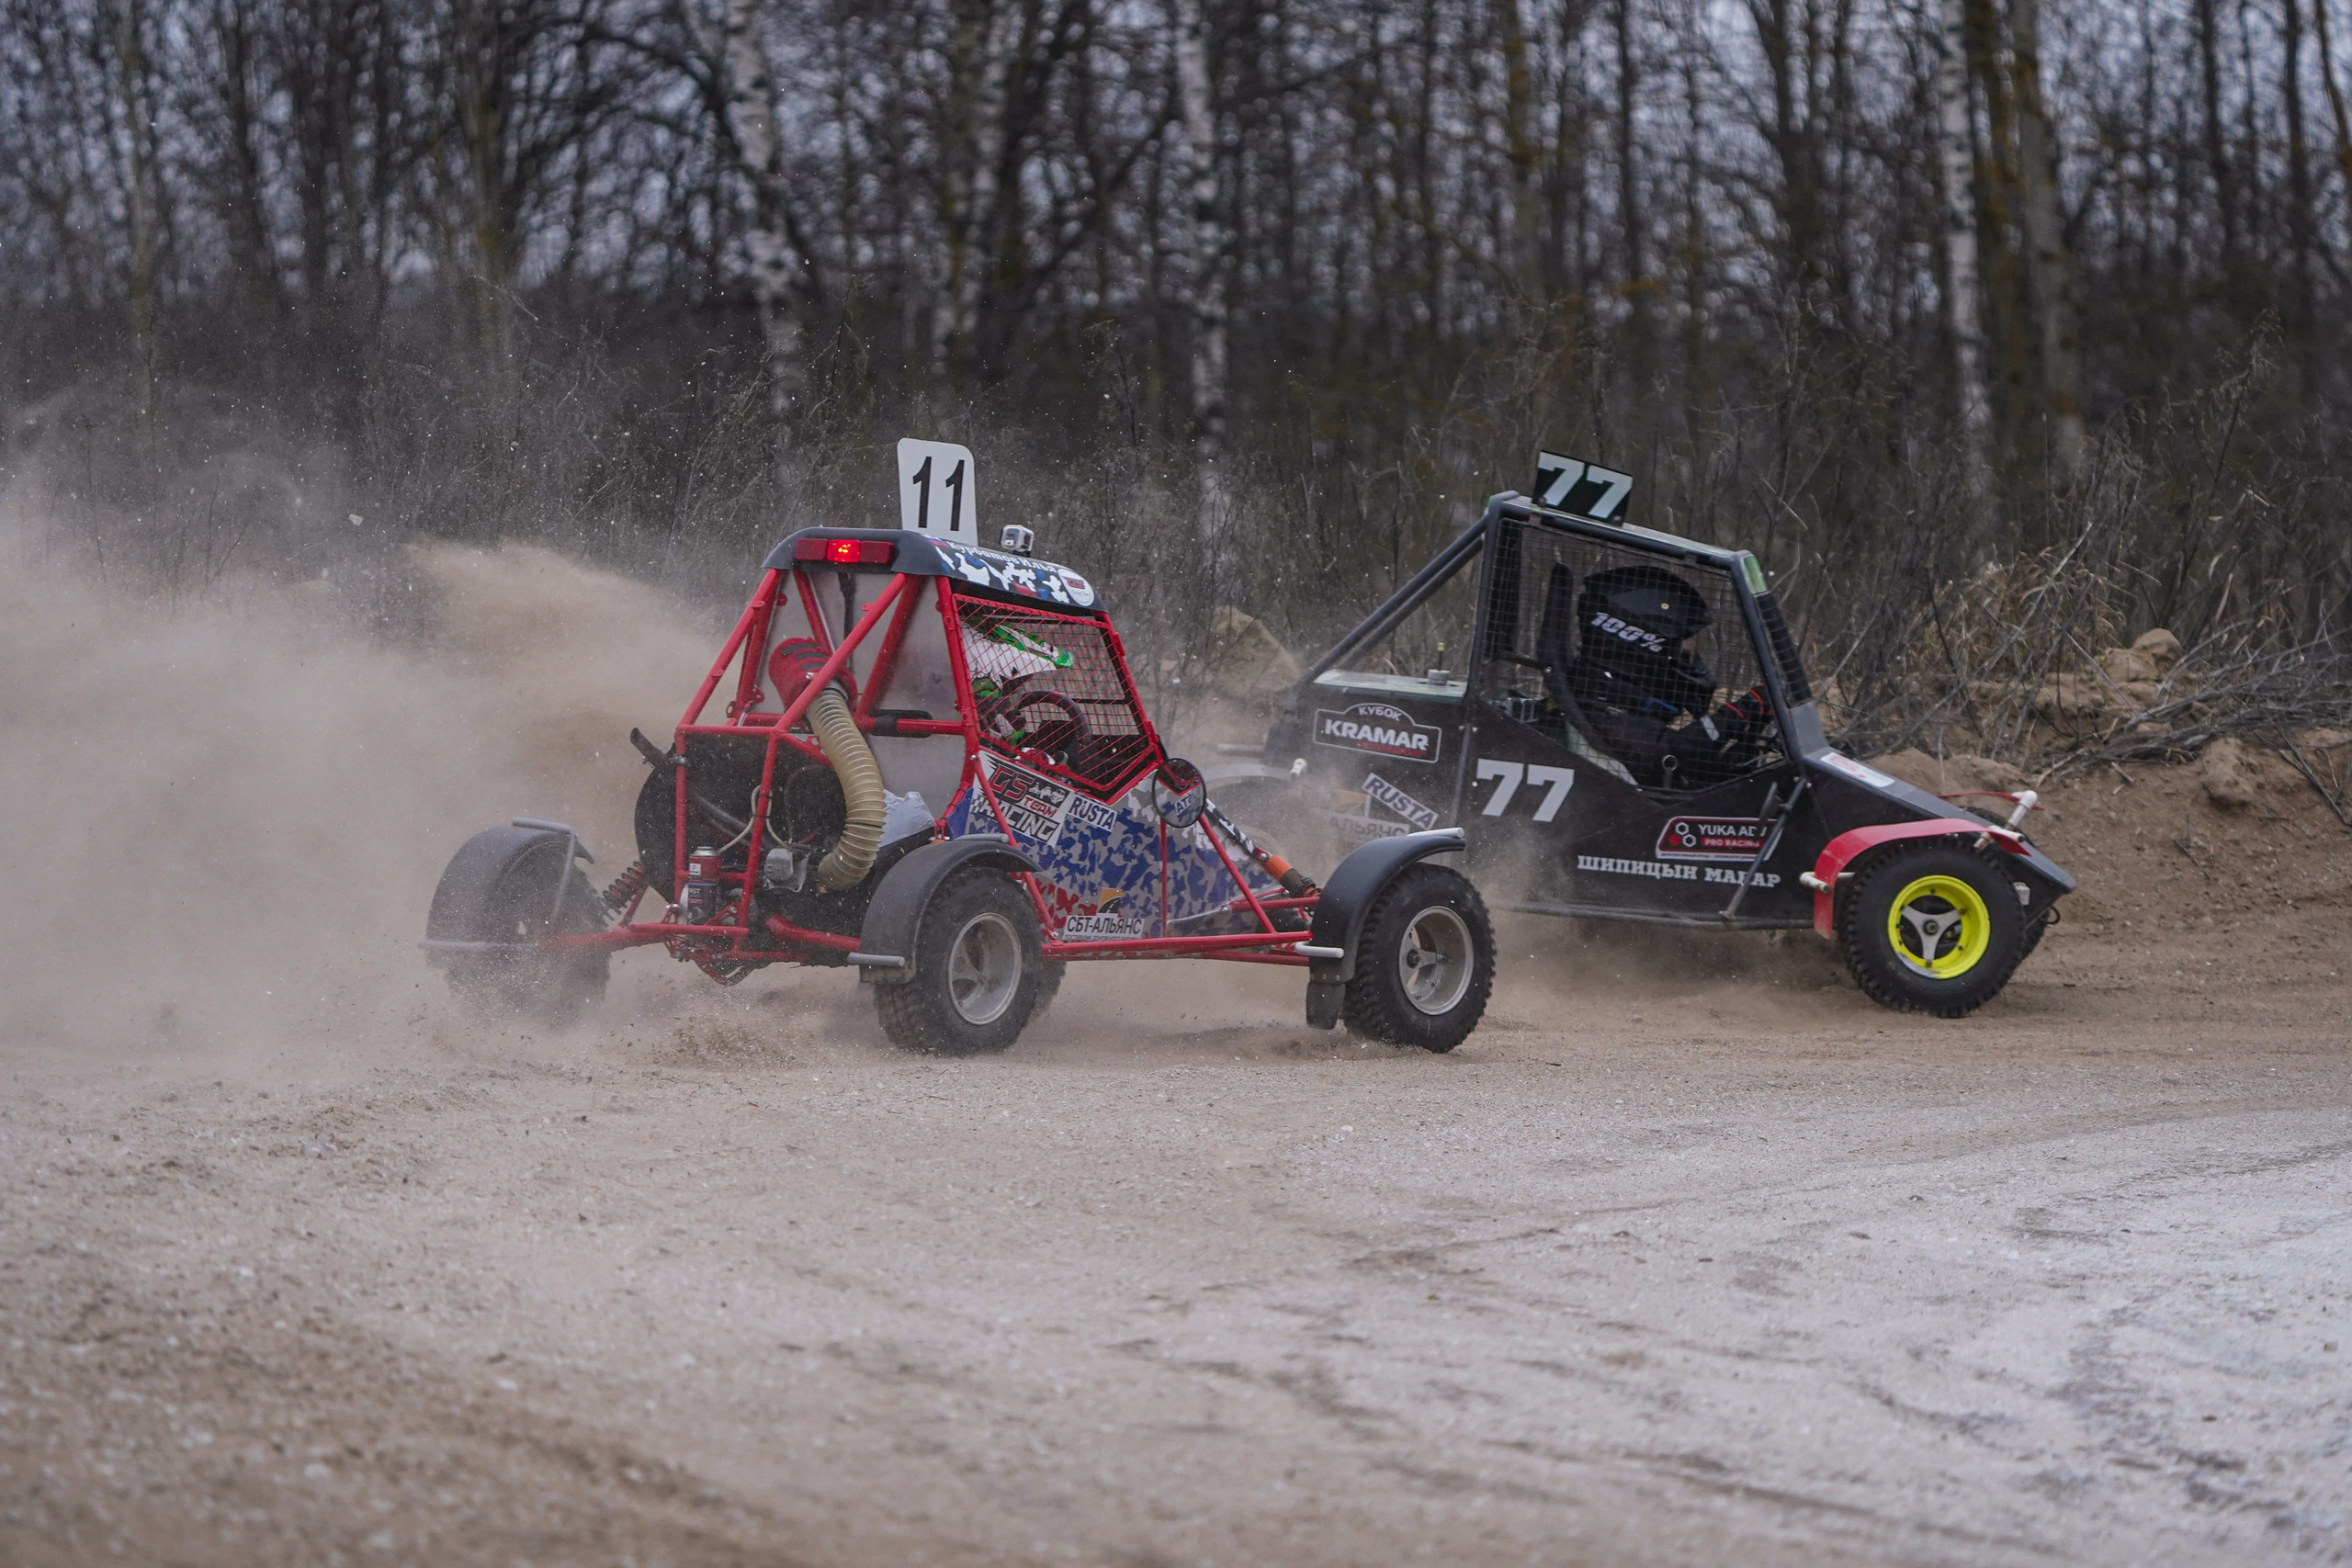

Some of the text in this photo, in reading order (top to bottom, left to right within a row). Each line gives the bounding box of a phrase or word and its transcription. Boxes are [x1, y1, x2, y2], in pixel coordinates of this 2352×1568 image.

[912, 456, 965, 531] 11
[1538, 452, 1633, 519] 77
[1590, 612, 1667, 653] 100%
[1359, 705, 1402, 722] КУБОК
[1325, 719, 1429, 750] KRAMAR
[1364, 777, 1434, 829] RUSTA
[1476, 758, 1575, 822] 77
[1023, 796, 1057, 818] TEAM
[1069, 797, 1115, 830] RUSTA
[1699, 824, 1736, 835] YUKA
[1577, 855, 1698, 879] ШИПИЦЫН
[1068, 916, 1143, 934] СБТ-АЛЬЯНС
